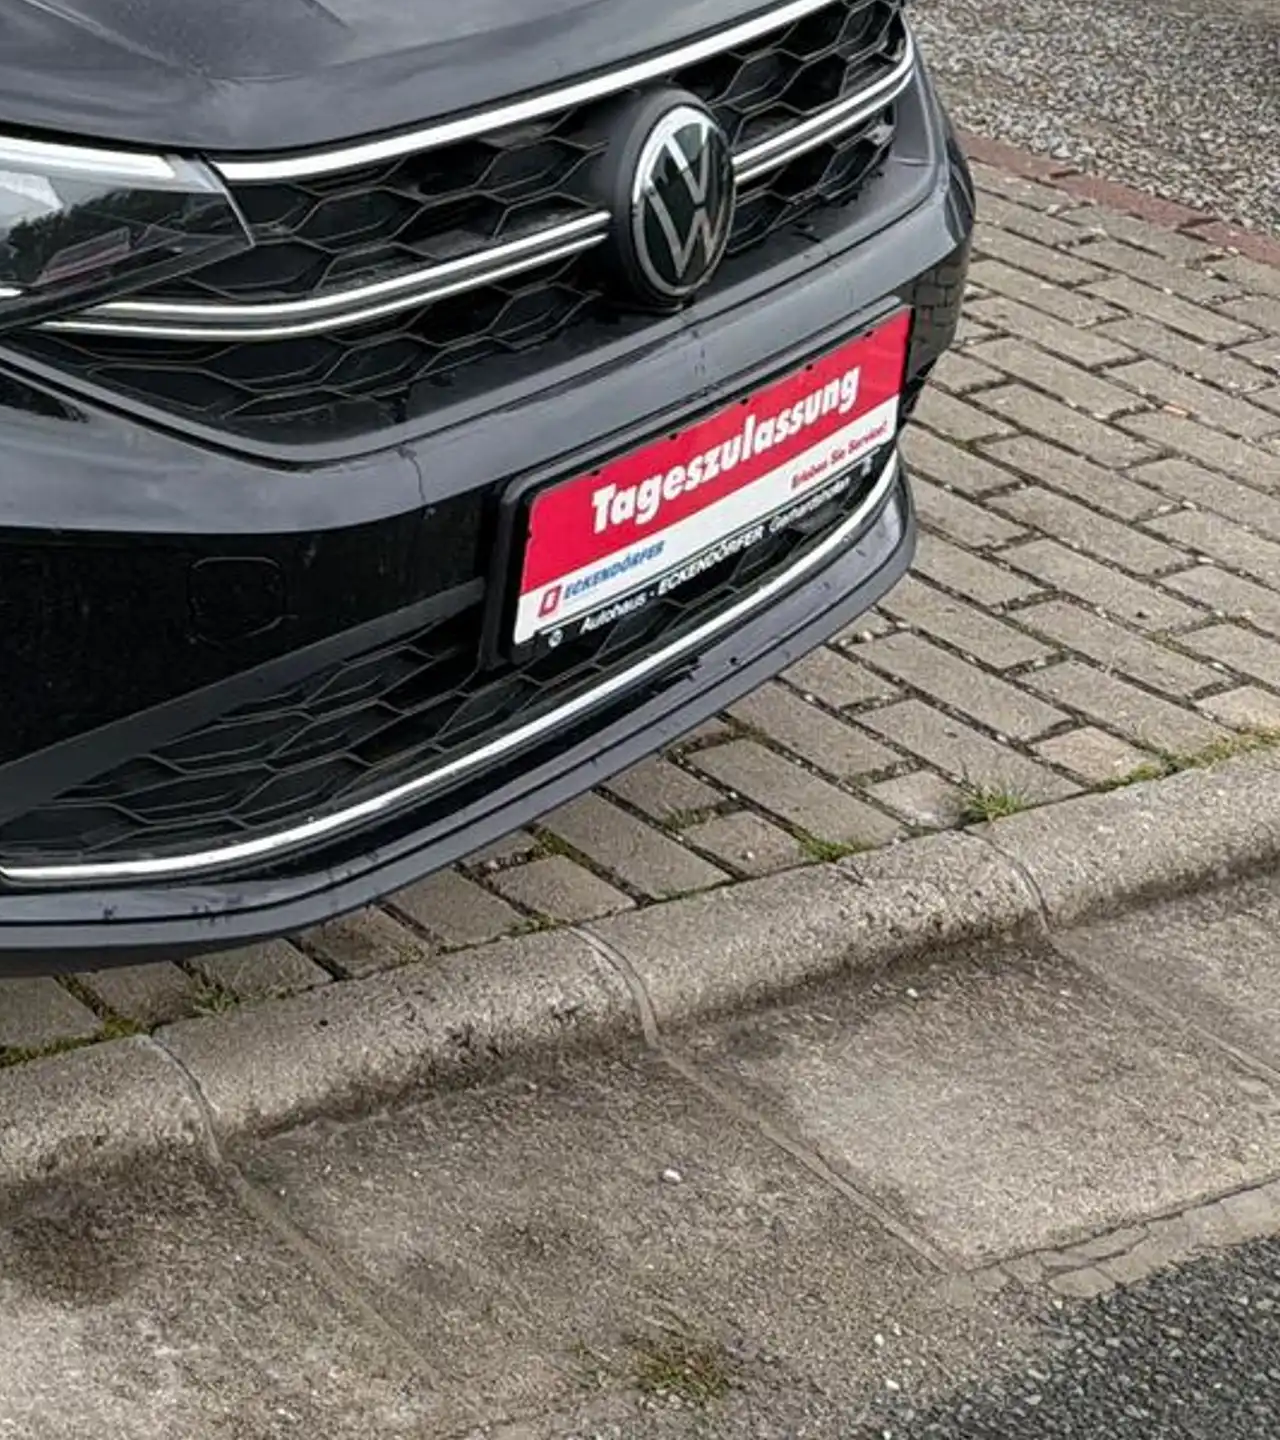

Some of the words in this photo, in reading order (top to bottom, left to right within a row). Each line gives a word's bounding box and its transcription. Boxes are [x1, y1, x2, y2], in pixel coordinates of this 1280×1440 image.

[593, 366, 861, 534] Tageszulassung
[579, 592, 647, 635] Autohaus
[658, 525, 765, 596] ECKENDÖRFER
